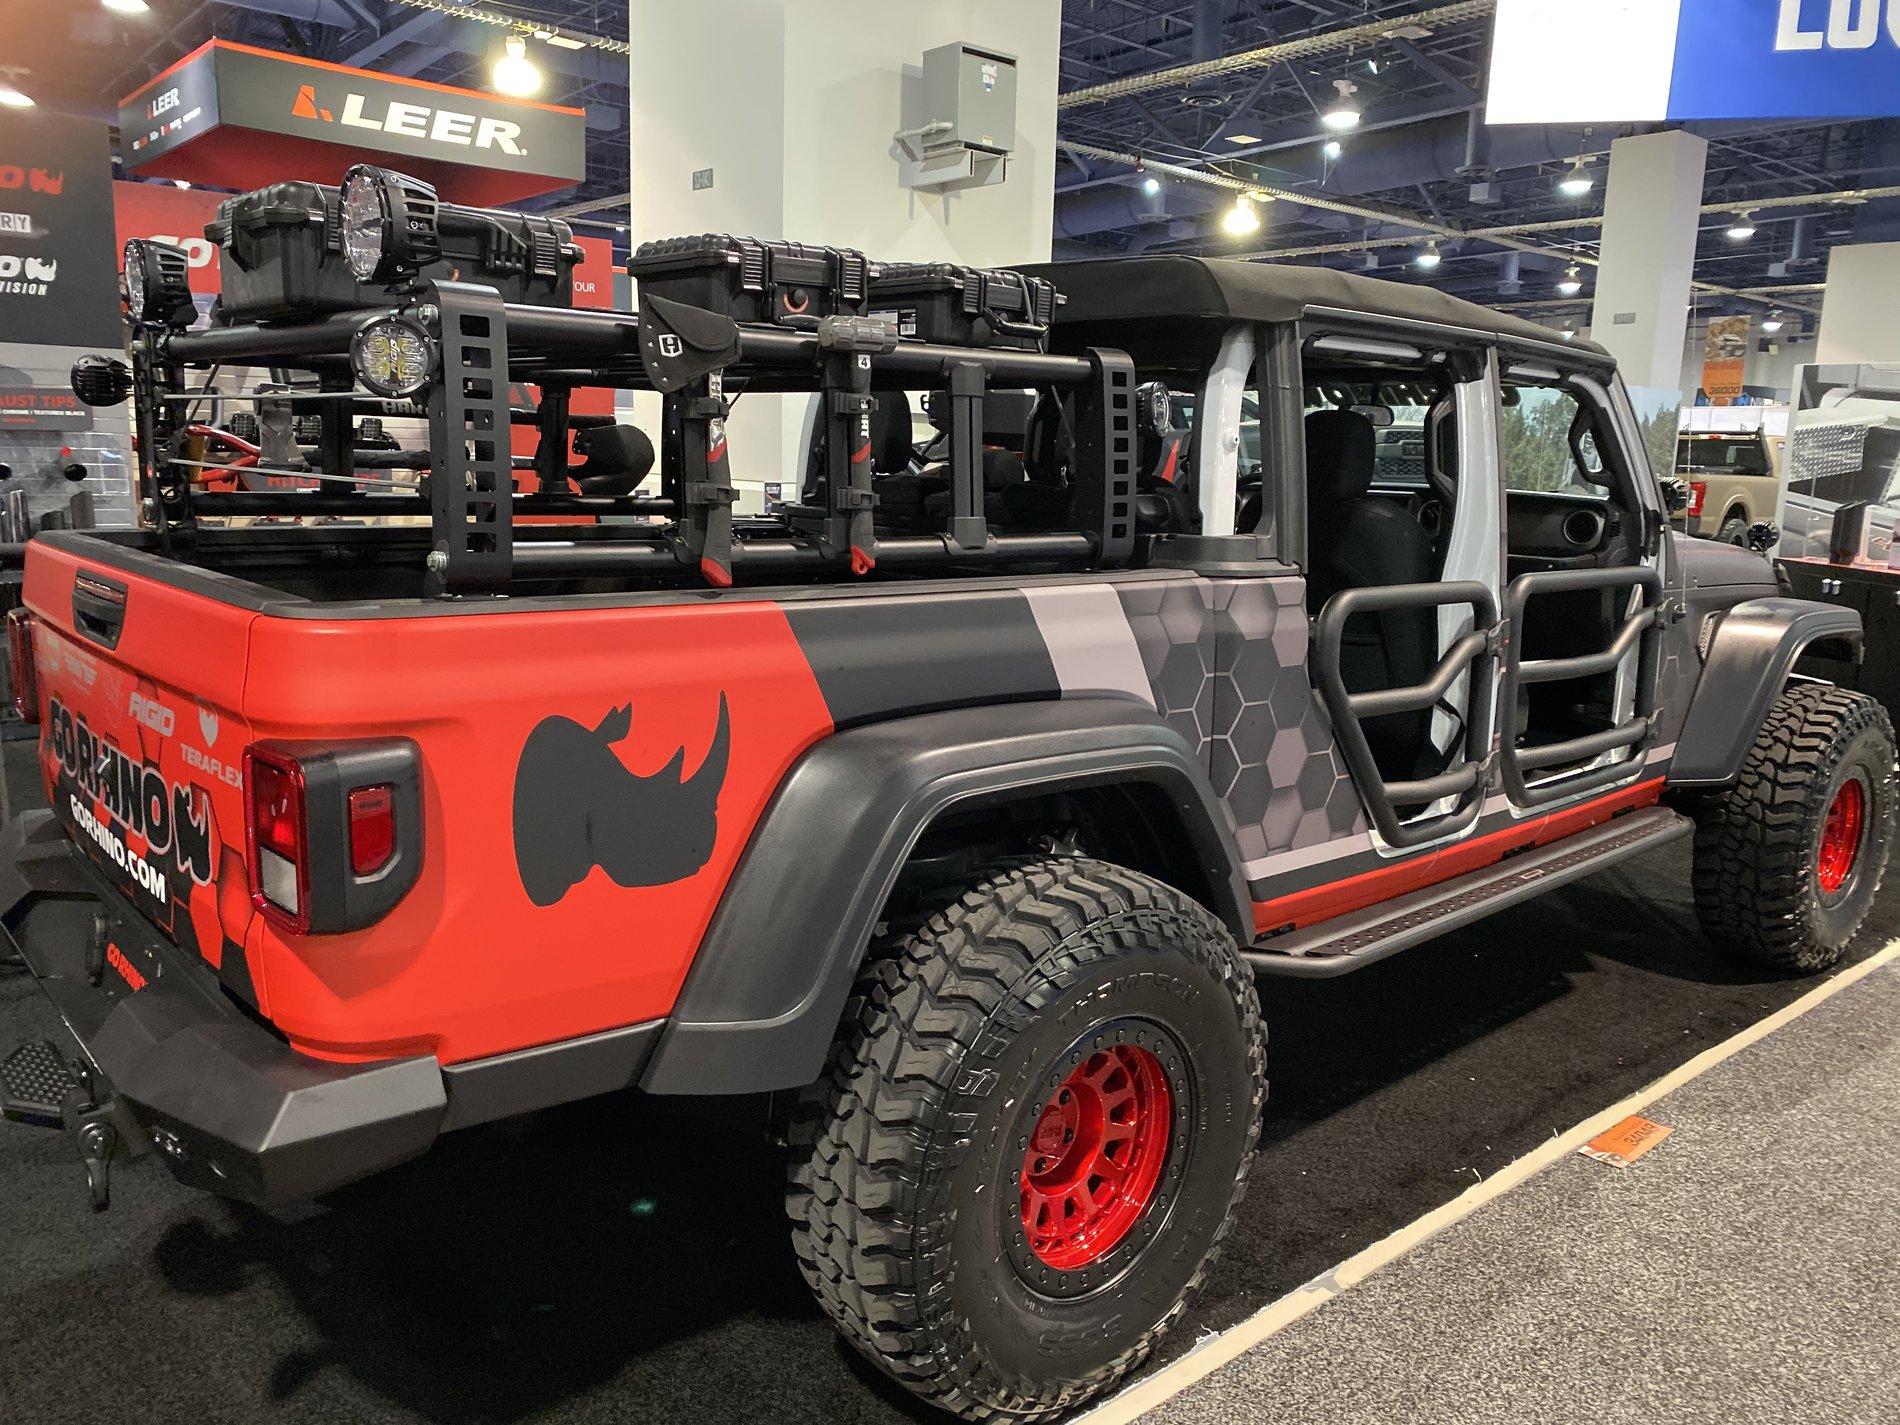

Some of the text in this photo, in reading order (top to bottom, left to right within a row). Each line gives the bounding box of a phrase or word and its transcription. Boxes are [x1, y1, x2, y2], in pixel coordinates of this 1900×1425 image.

[152, 87, 180, 117] LEER
[341, 93, 523, 156] LEER
[573, 281, 595, 293] OUR
[41, 395, 77, 408] TIPS
[128, 691, 176, 738] RIGID
[180, 743, 244, 792] TERAFLEX
[70, 793, 166, 904] GORHINO.COM
